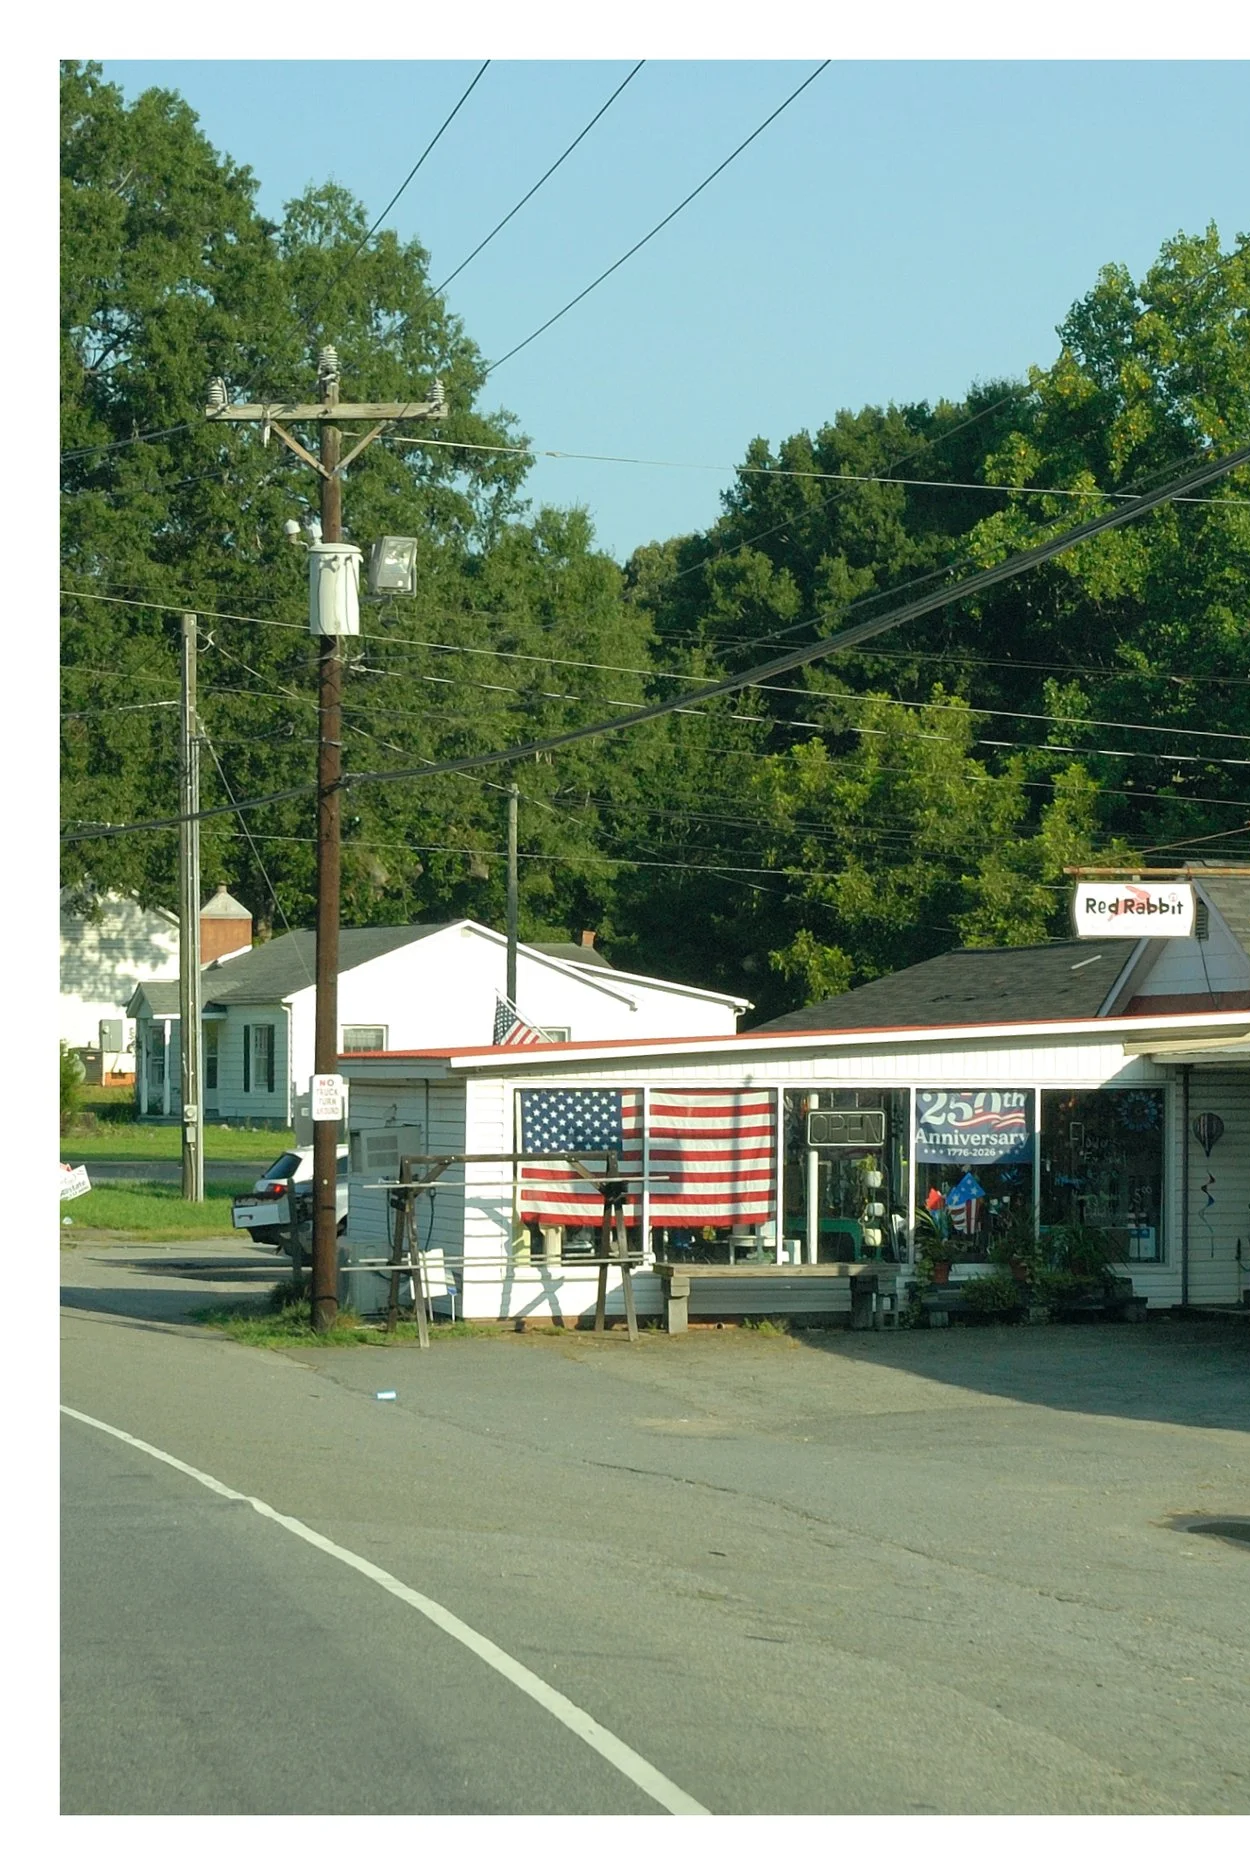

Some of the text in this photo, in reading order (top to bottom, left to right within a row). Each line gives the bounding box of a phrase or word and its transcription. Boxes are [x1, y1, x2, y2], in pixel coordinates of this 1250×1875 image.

[1085, 893, 1184, 915] Red Rabbit
[316, 1088, 339, 1096] TRUCK
[319, 1079, 335, 1087] NO
[920, 1092, 1025, 1126] 250th
[811, 1114, 882, 1143] OPEN
[915, 1128, 1029, 1148] Anniversary
[946, 1148, 996, 1157] 1776-2026
